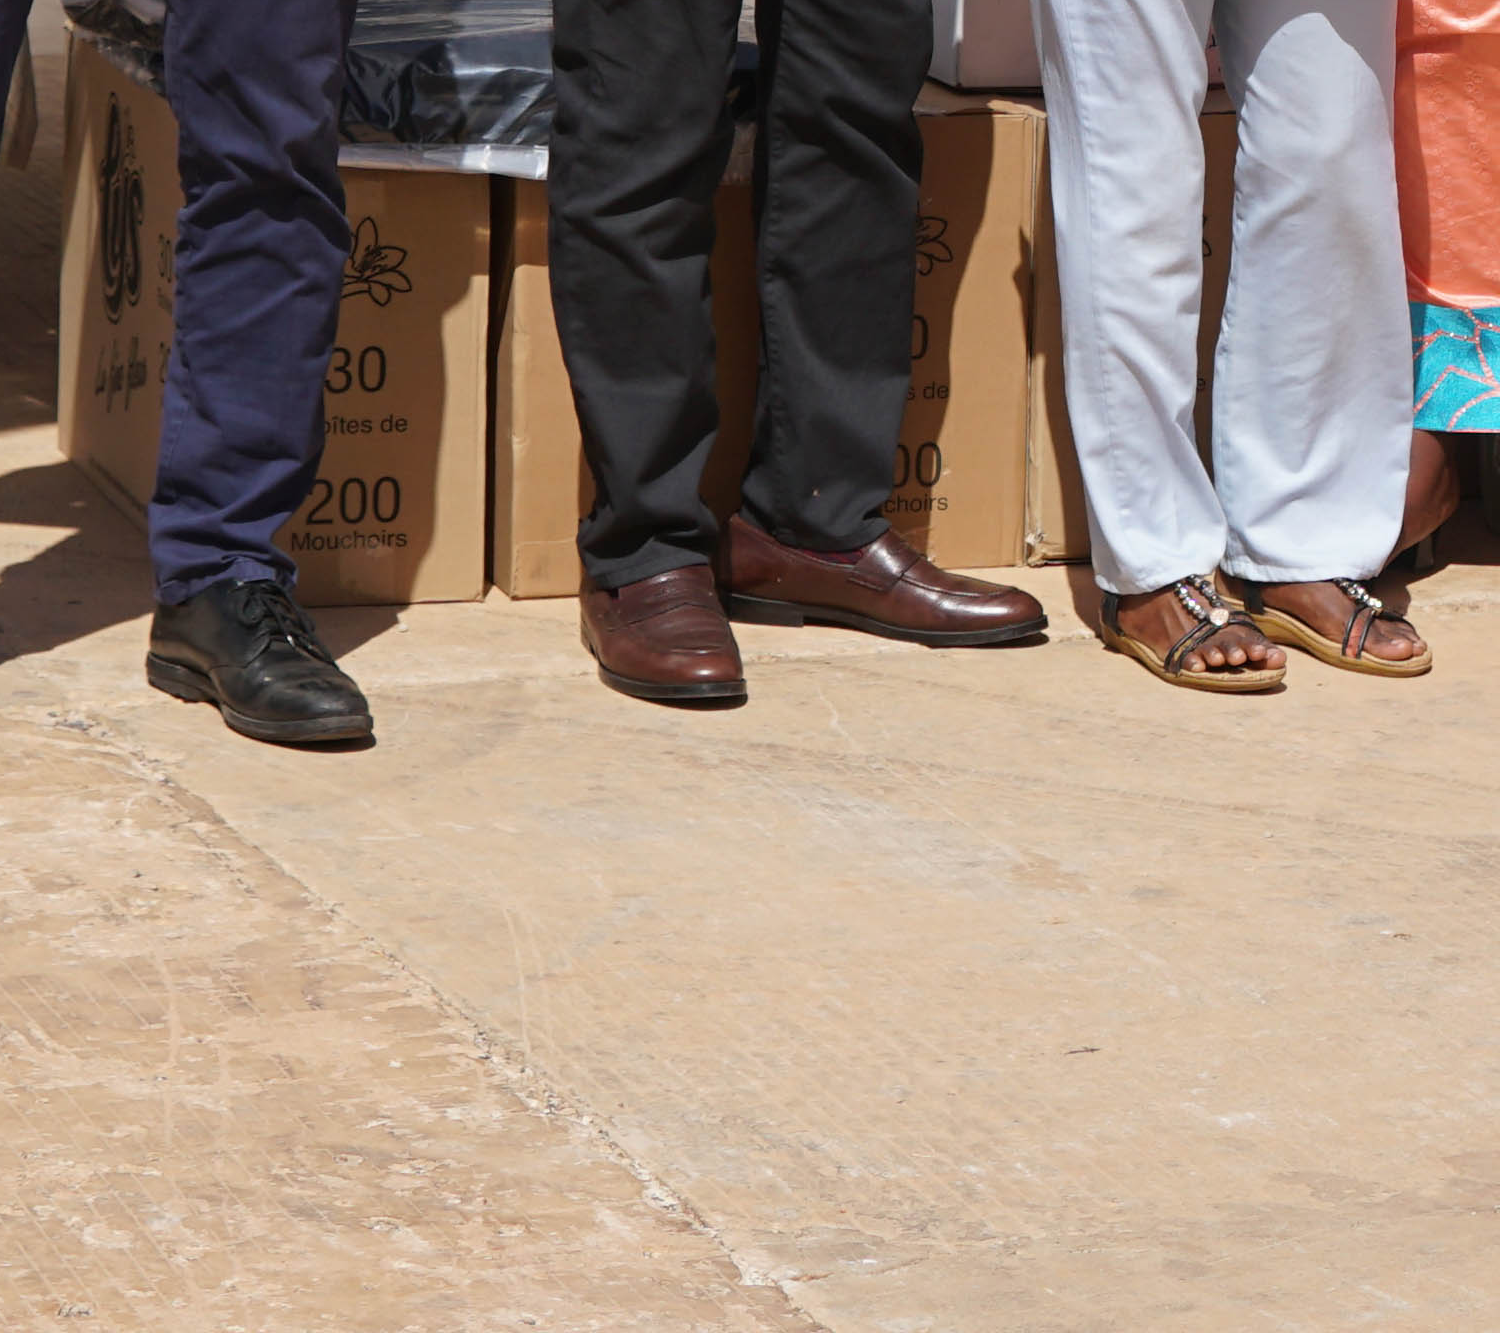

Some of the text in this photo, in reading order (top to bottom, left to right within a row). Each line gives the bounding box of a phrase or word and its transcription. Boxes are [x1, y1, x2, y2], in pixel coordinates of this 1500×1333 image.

[909, 314, 929, 360] 0
[325, 346, 387, 394] 30
[923, 382, 949, 400] de
[325, 414, 409, 434] oîtes de
[306, 476, 402, 525] 200
[884, 493, 949, 513] choirs
[291, 530, 409, 552] Mouchoirs
